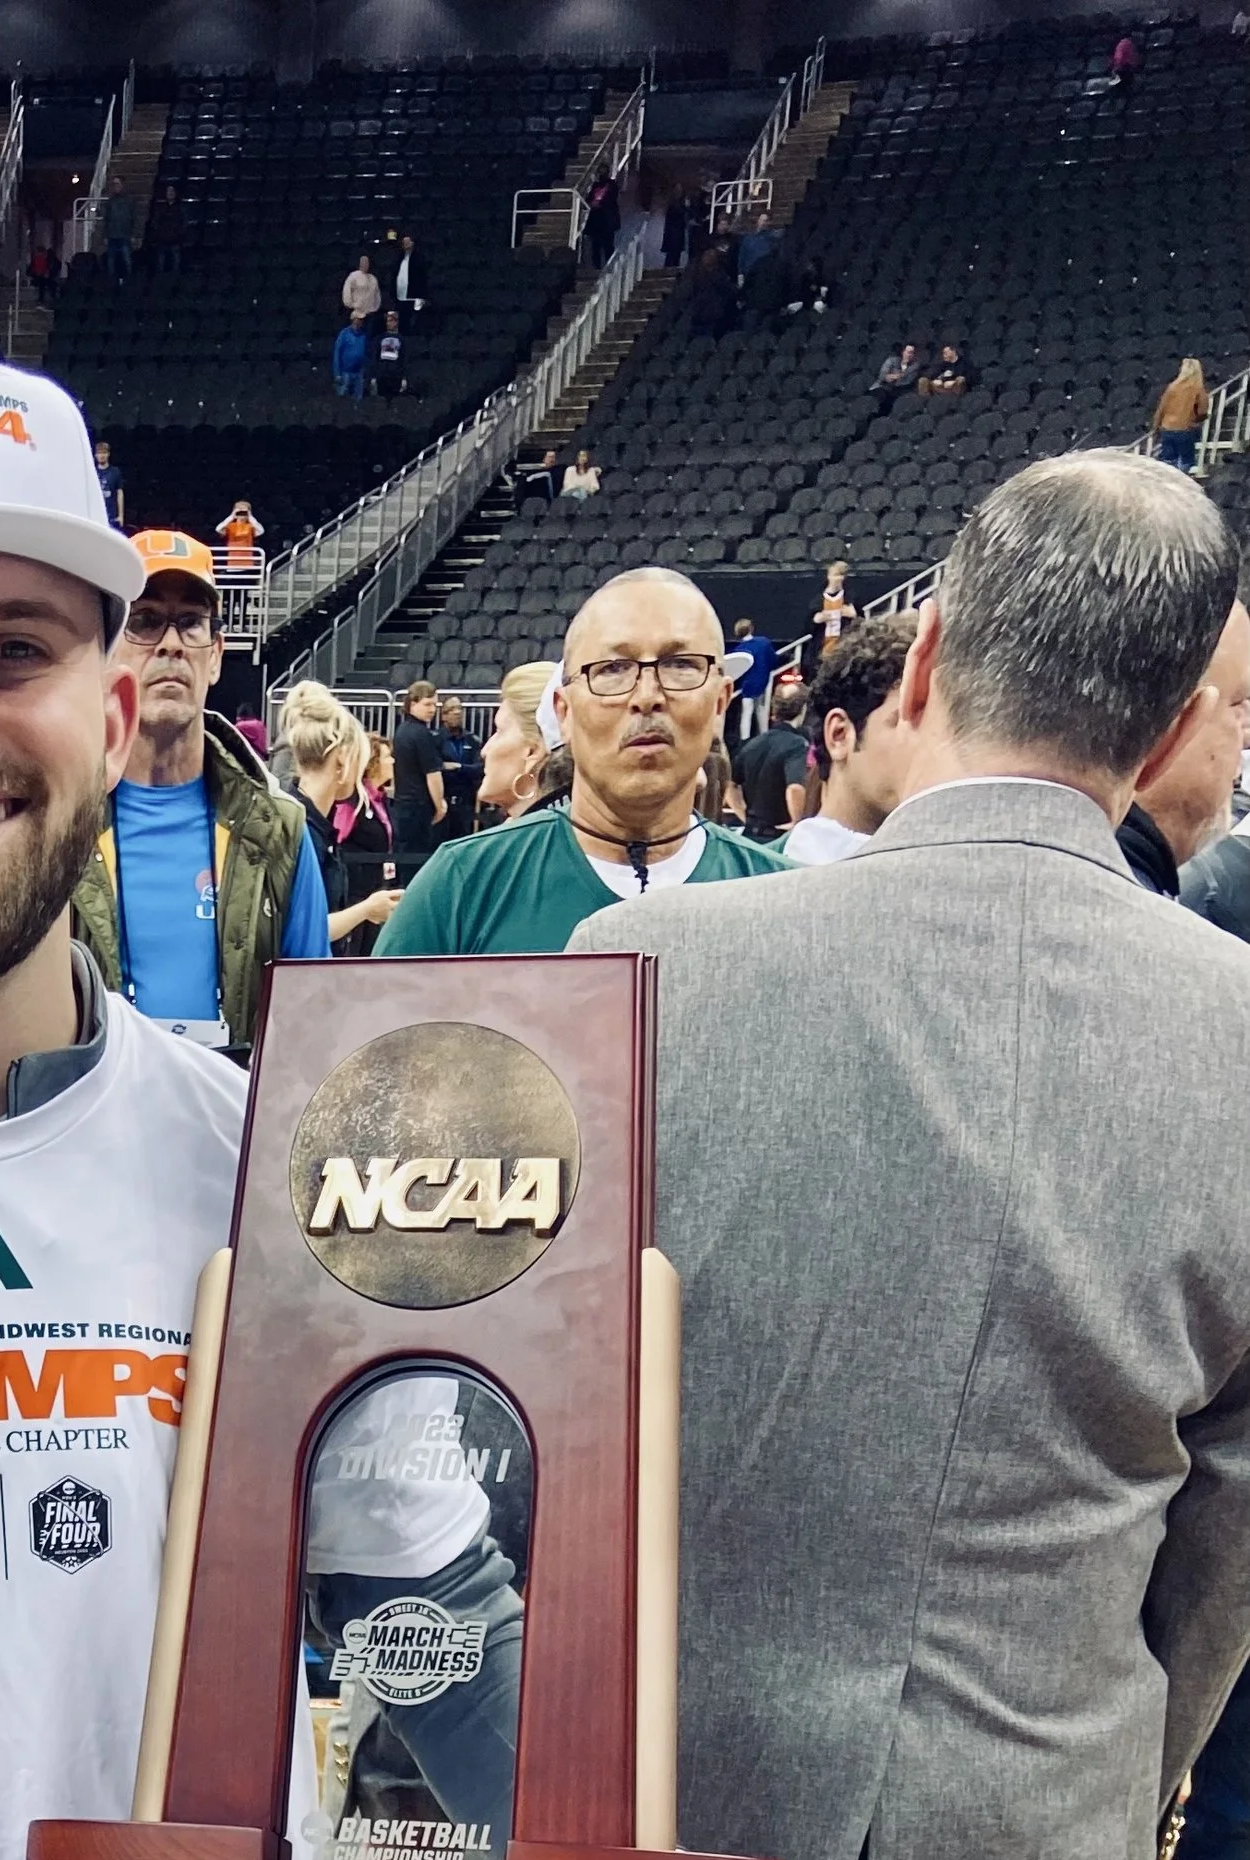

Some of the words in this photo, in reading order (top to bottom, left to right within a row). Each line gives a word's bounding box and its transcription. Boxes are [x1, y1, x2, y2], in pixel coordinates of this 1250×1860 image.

[305, 1157, 563, 1238] NCAA
[5, 1427, 130, 1453] CHAPTER
[337, 1446, 491, 1483] DIVISION
[44, 1499, 98, 1526] FINAL
[49, 1521, 102, 1549] FOUR
[367, 1625, 446, 1648] MARCH
[375, 1648, 480, 1673] MADNESS
[337, 1817, 492, 1851] BASKETBALL
